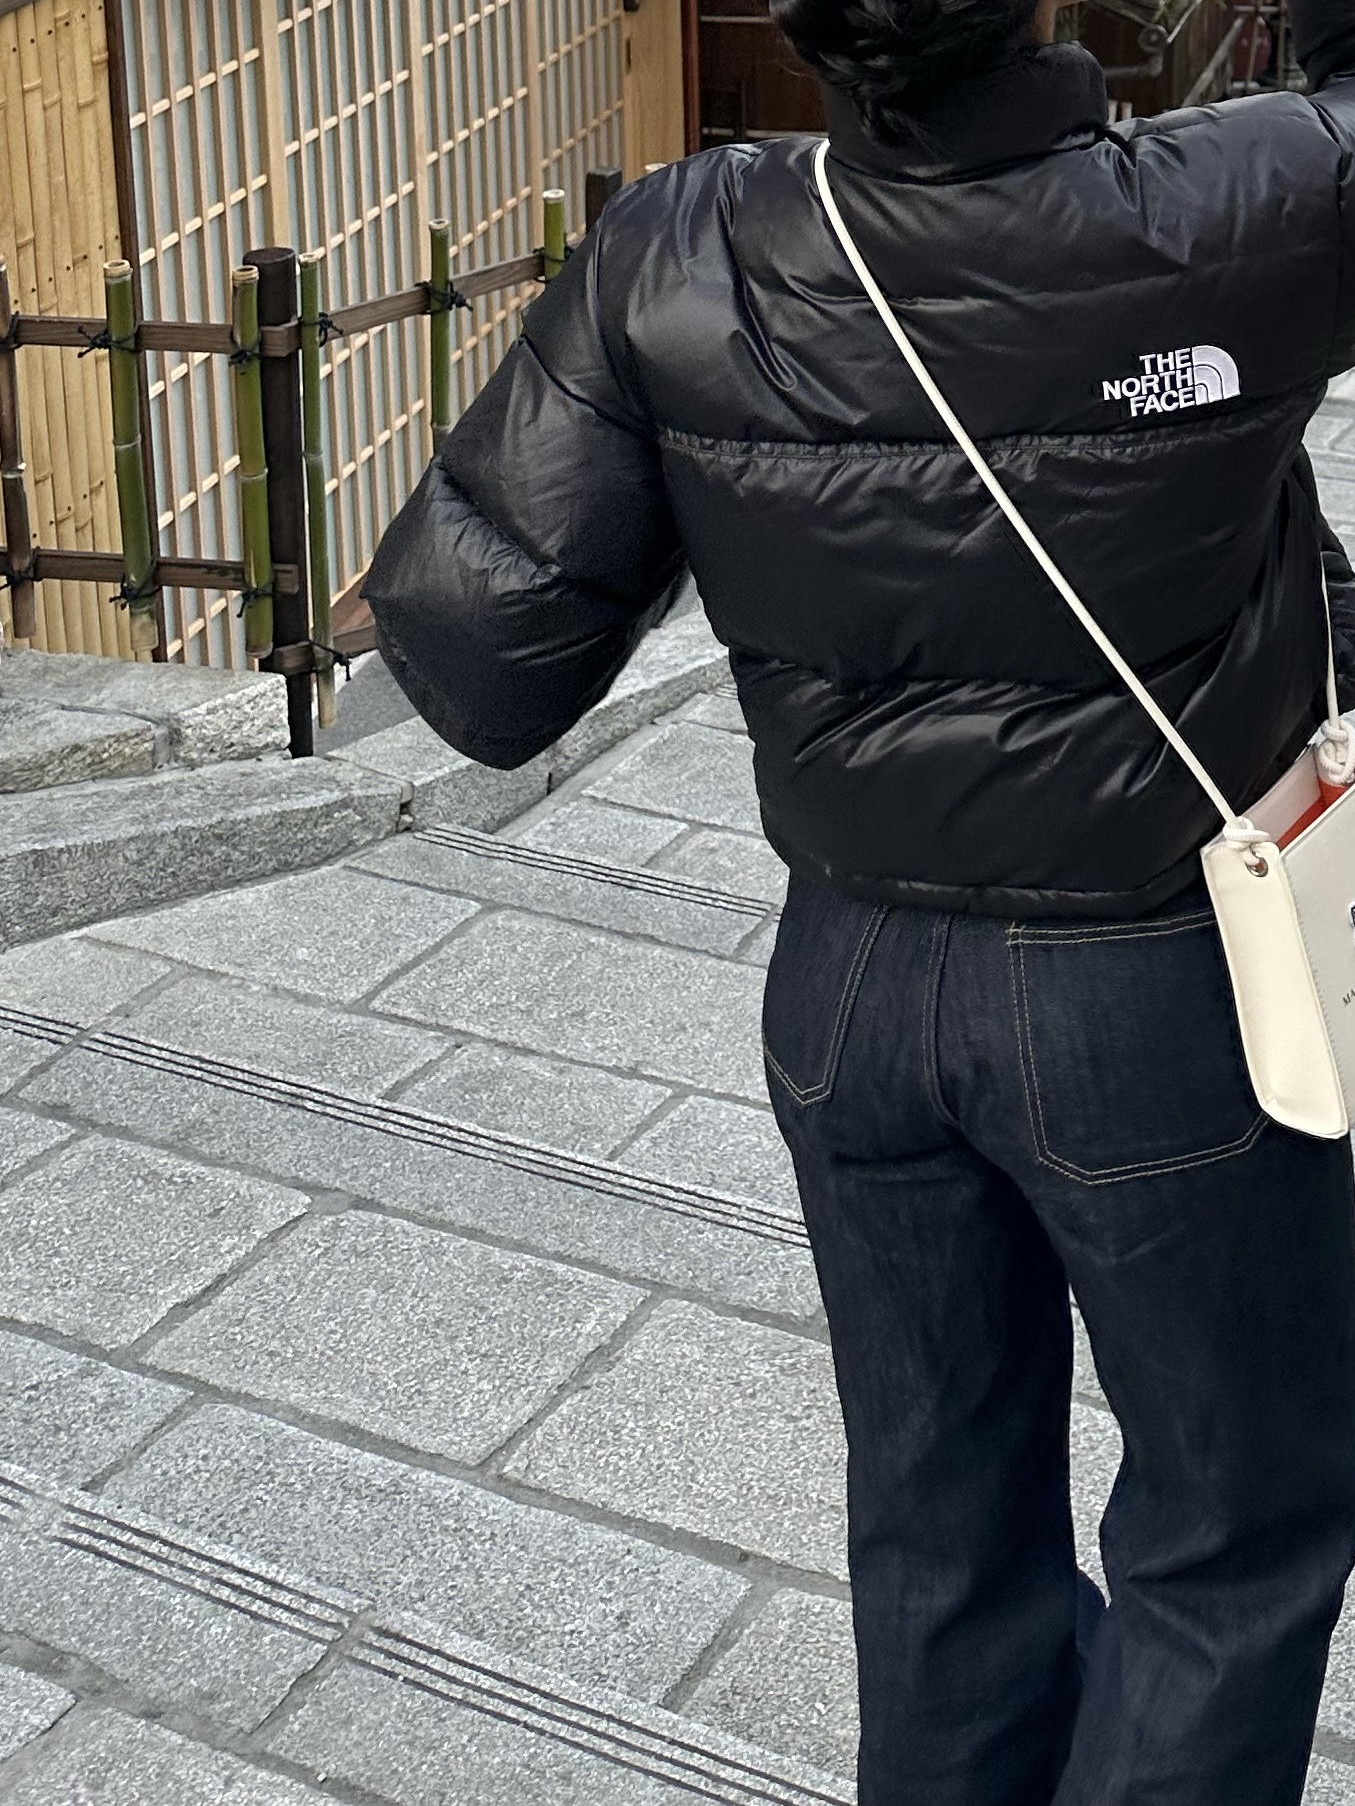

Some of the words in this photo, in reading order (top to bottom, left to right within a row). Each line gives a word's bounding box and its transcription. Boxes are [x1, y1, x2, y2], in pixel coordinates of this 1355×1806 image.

[1138, 347, 1192, 375] THE
[1102, 367, 1194, 401] NORTH
[1130, 386, 1196, 418] FACE
